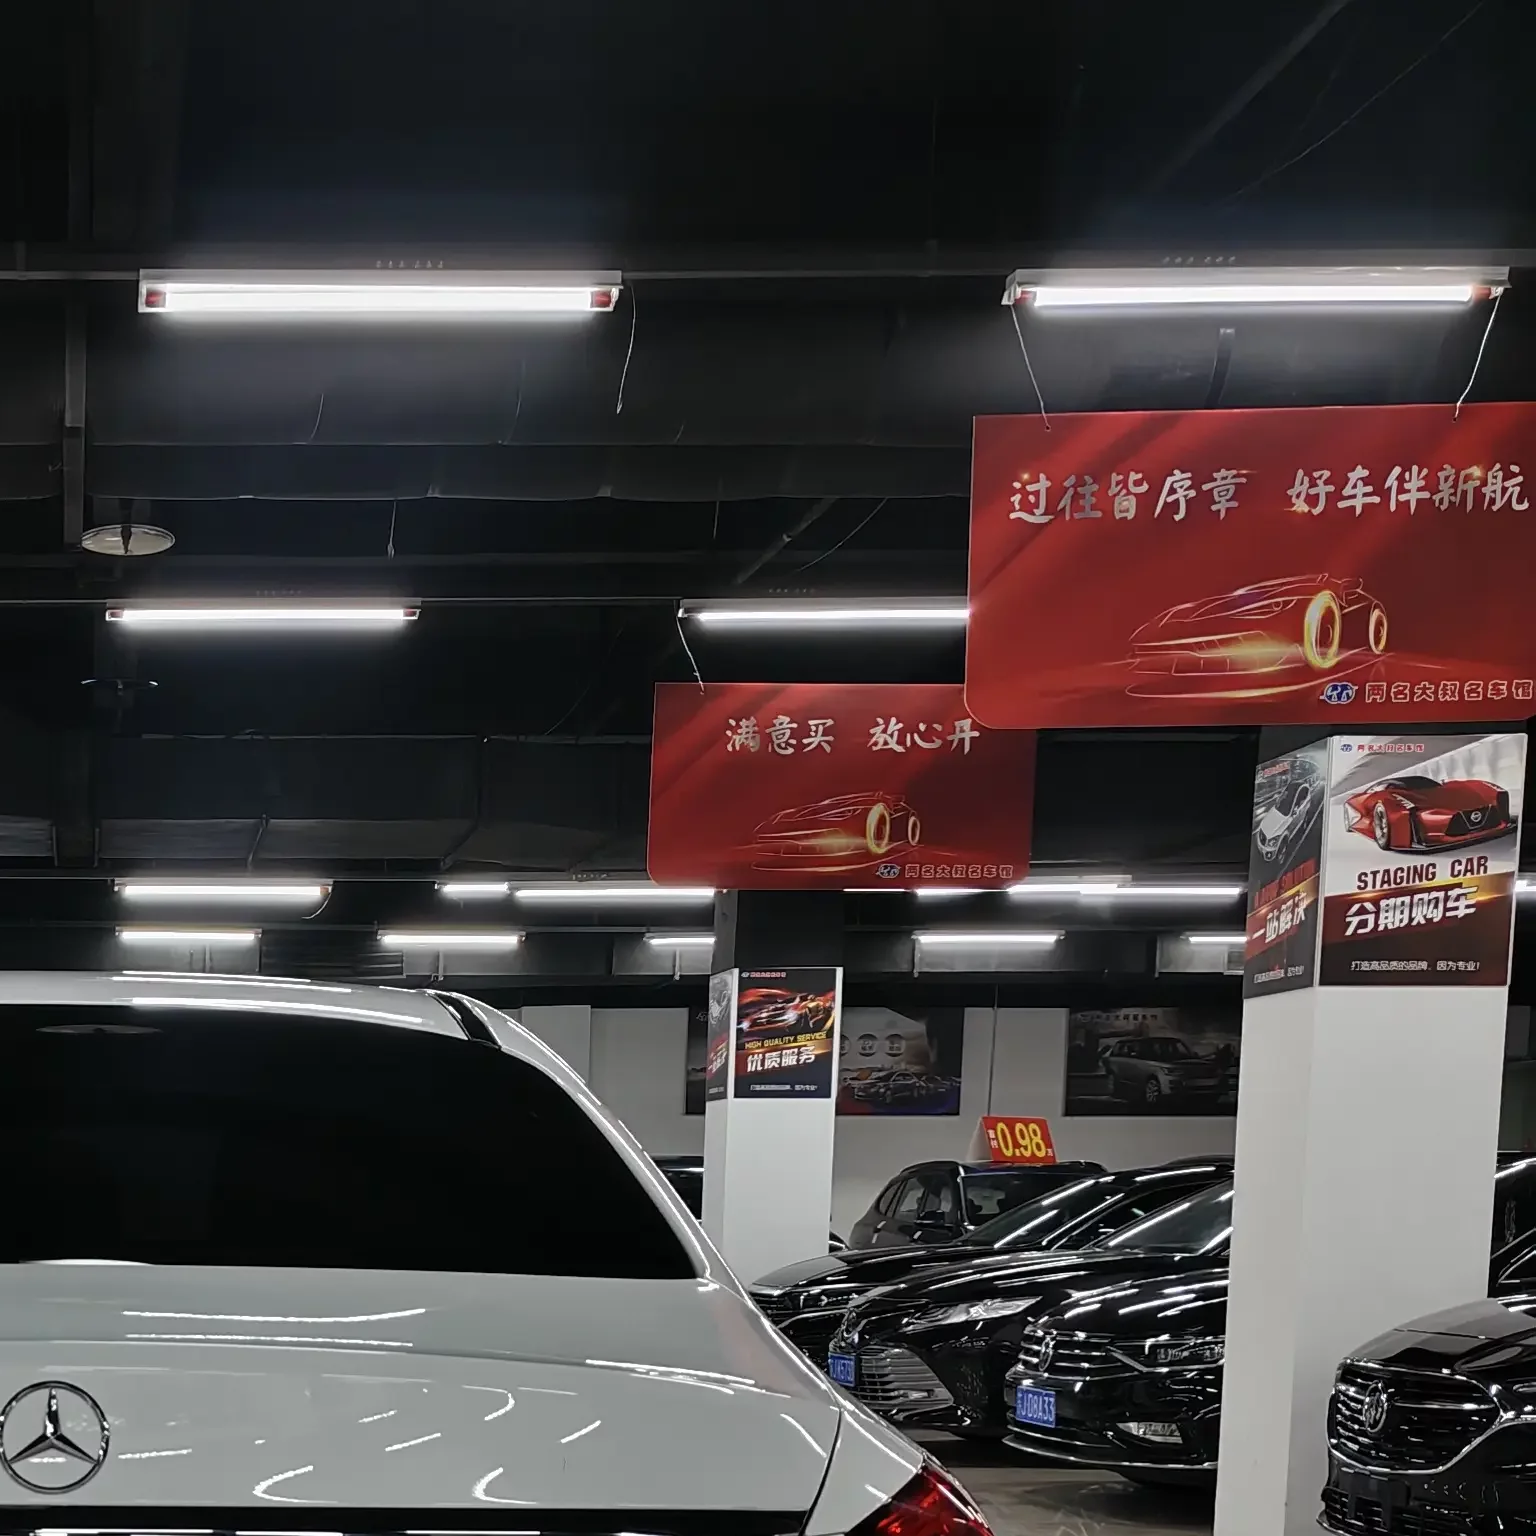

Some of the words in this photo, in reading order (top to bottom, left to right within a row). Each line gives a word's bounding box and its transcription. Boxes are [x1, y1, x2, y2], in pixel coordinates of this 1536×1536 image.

[1008, 467, 1248, 523] 过往皆序章
[1286, 463, 1531, 517] 好车伴新航
[1365, 679, 1534, 703] 两名大叔名车馆
[724, 714, 835, 755] 满意买
[867, 717, 981, 755] 放心开
[1357, 862, 1437, 891] STAGING
[1450, 855, 1489, 879] CAR
[1344, 886, 1479, 936] 分期购车
[763, 1036, 795, 1047] QUALITY
[796, 1031, 827, 1042] SERVICE
[746, 1046, 816, 1073] 优质服务
[996, 1122, 1046, 1157] 0.98
